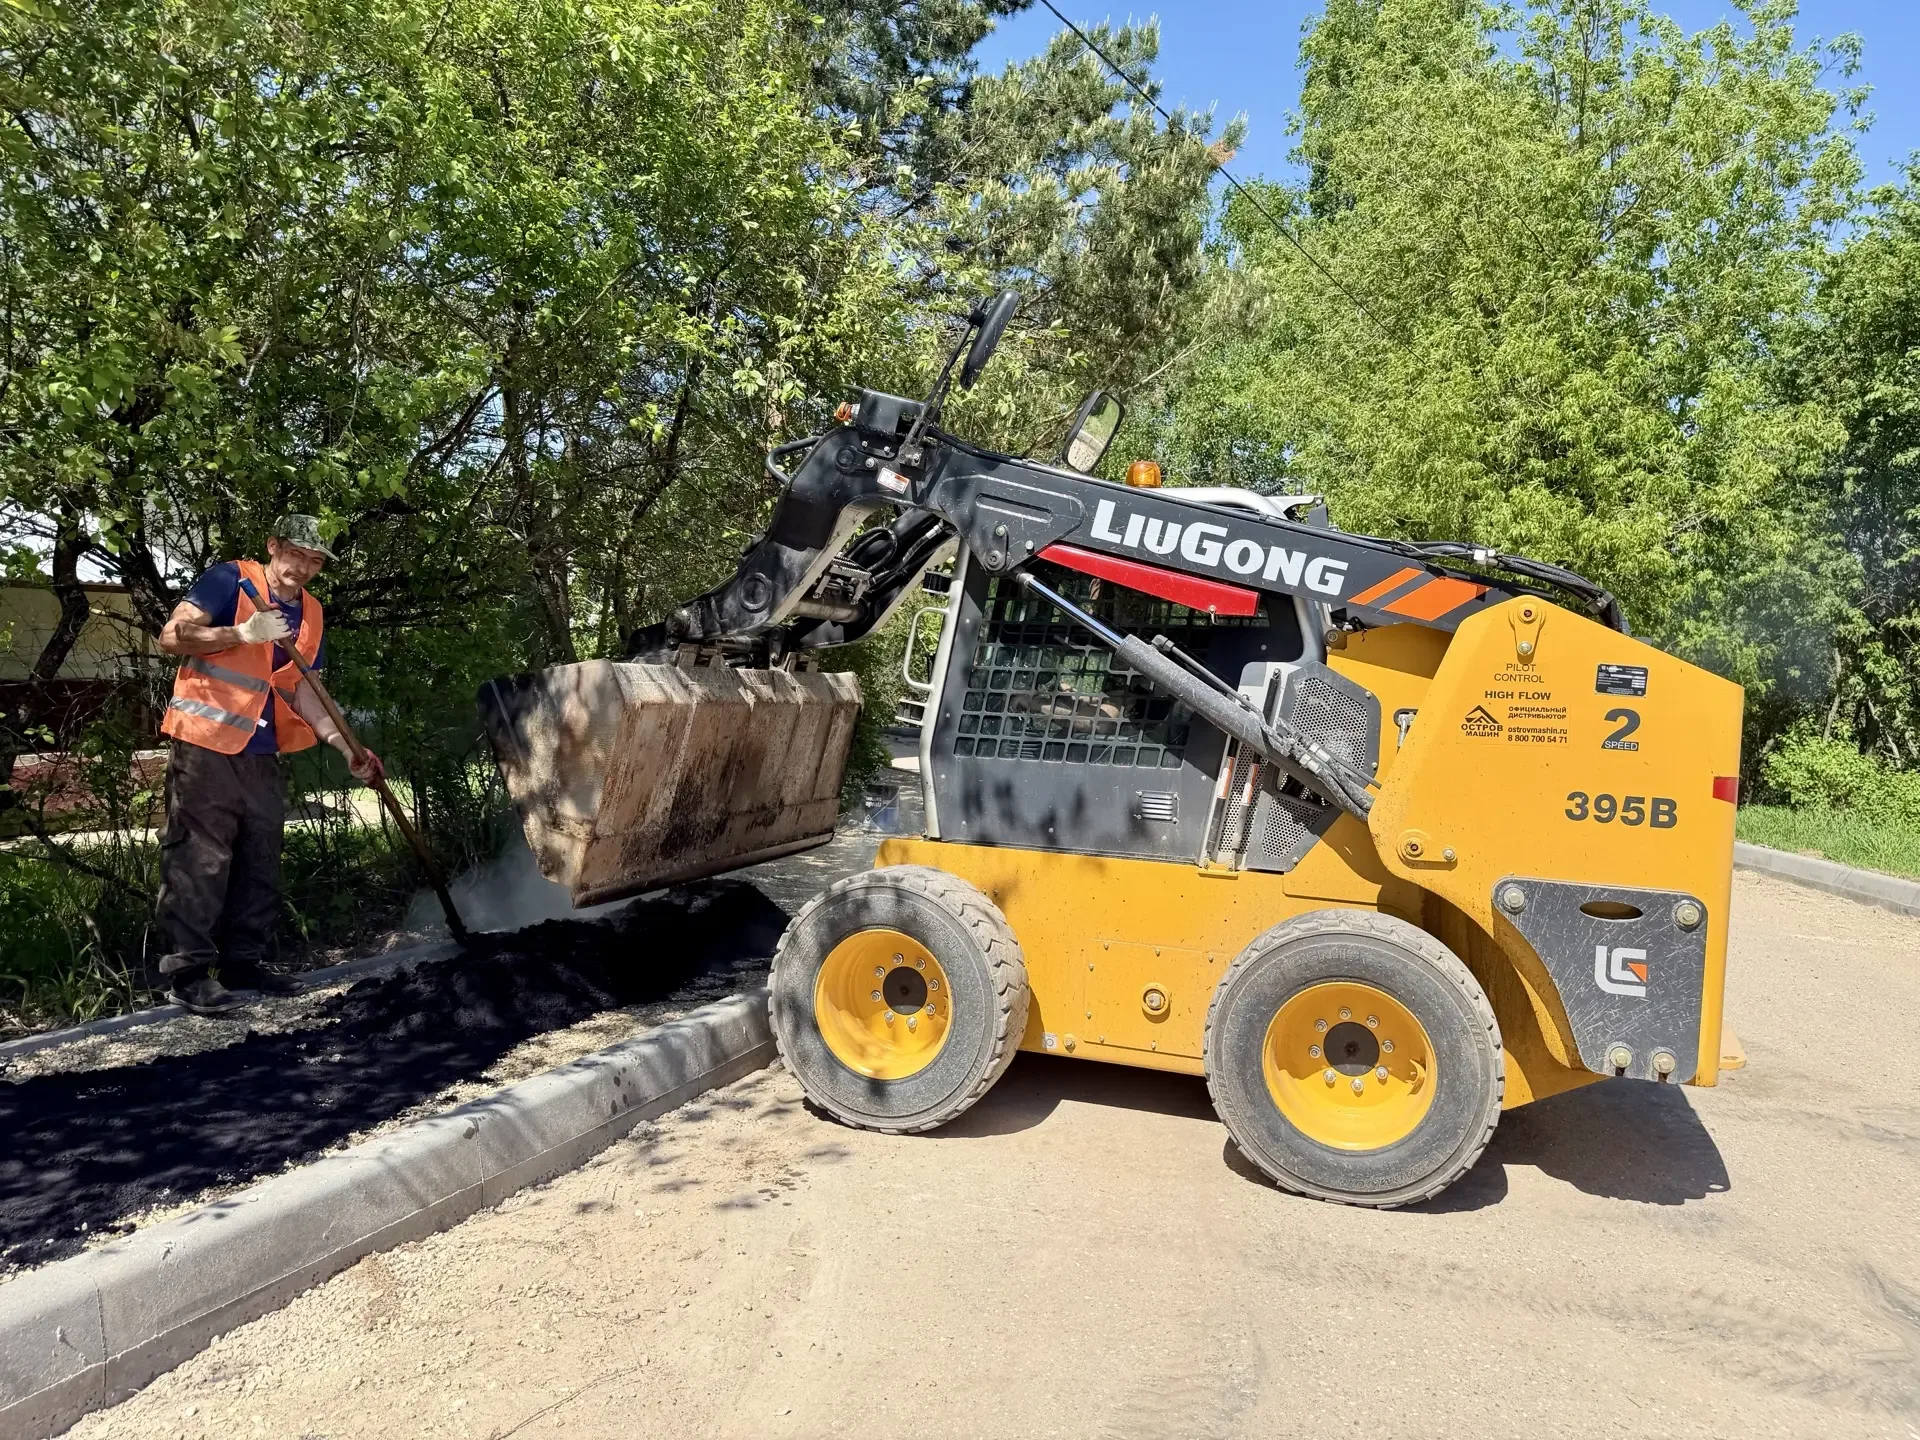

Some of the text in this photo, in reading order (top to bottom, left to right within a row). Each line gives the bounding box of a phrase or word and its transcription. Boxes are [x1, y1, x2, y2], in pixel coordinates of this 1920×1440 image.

[1506, 663, 1536, 672] PILOT
[1494, 673, 1544, 683] CONTROL
[1484, 690, 1551, 700] HIGH FLOW
[1461, 724, 1504, 732] ОСТРОВ
[1508, 726, 1567, 735] ostrovmashin.ru
[1600, 708, 1641, 751] 2
[1531, 735, 1545, 743] 700
[1604, 740, 1638, 750] SPEED
[1564, 791, 1678, 829] 395B
